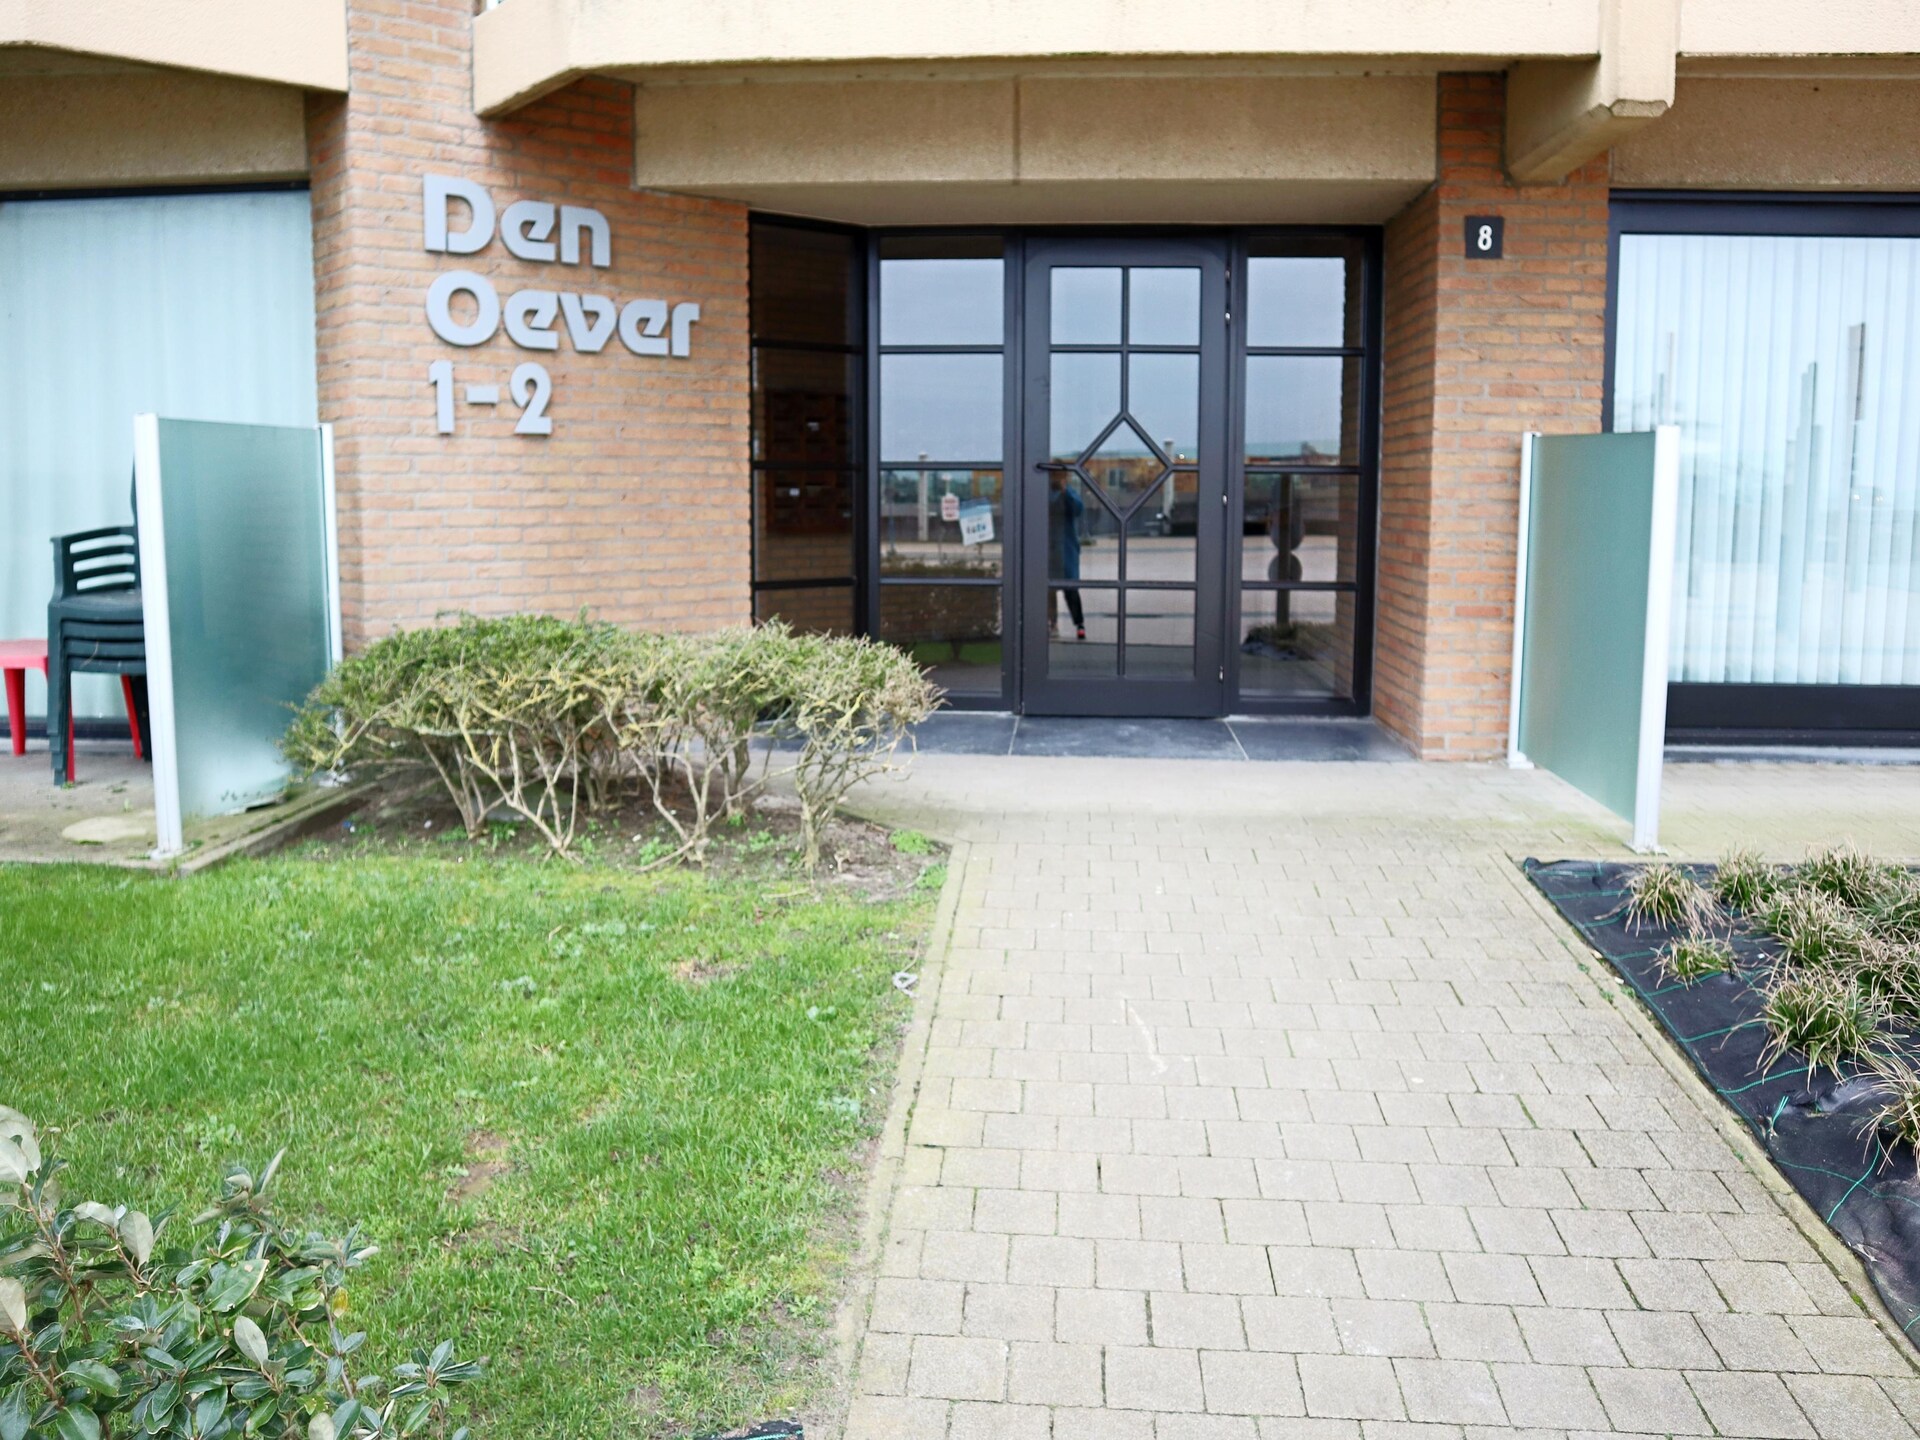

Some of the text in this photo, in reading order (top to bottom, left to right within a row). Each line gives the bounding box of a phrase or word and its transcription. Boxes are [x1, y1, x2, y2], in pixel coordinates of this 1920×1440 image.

[423, 174, 611, 267] Den
[1477, 224, 1493, 251] 8
[425, 270, 700, 357] Oever
[428, 360, 552, 434] 1-2
